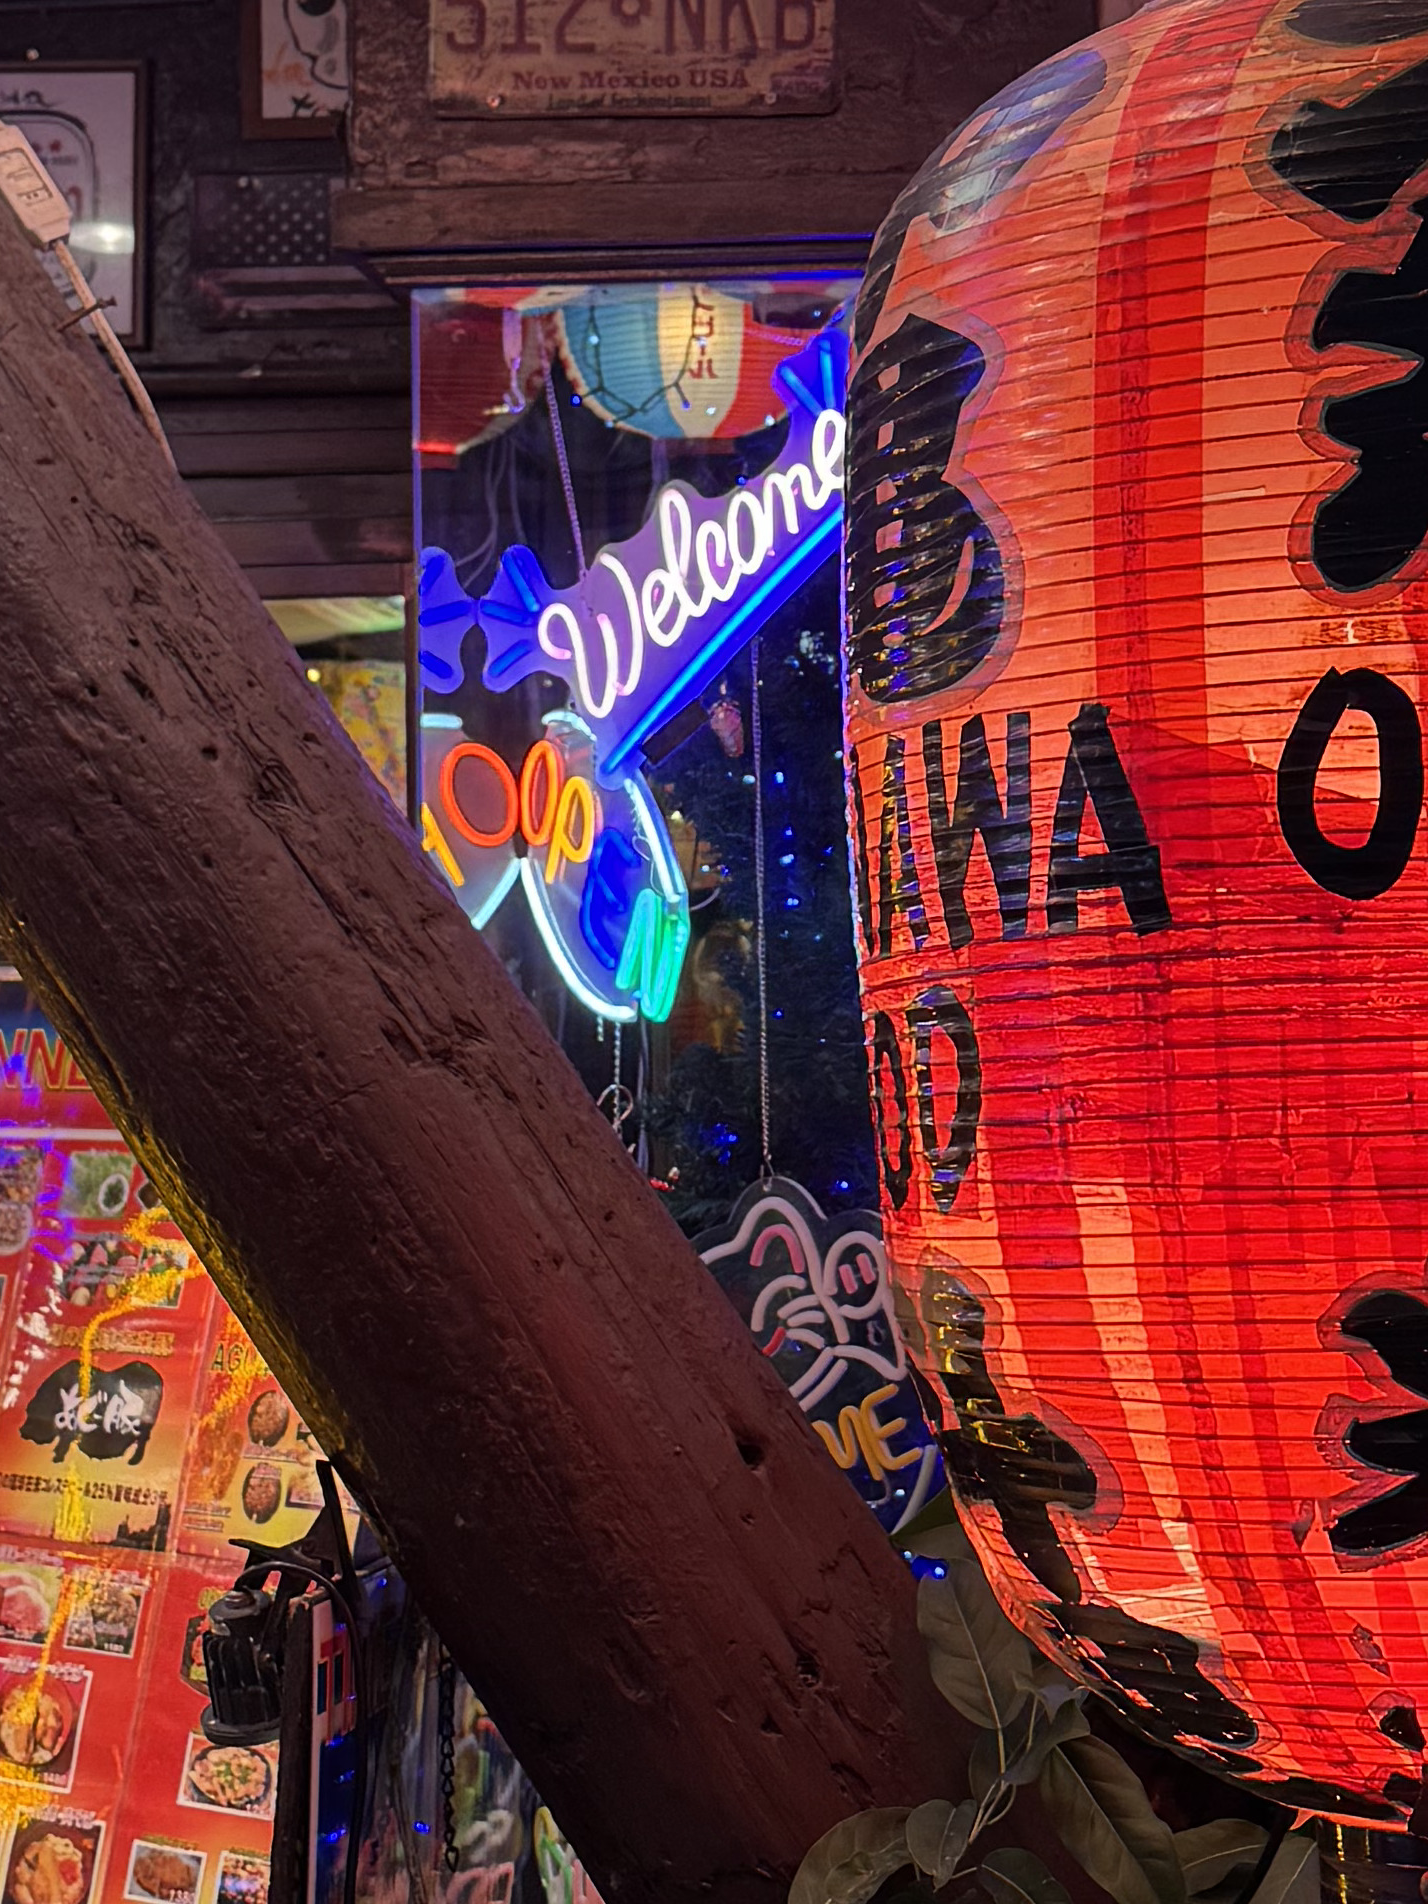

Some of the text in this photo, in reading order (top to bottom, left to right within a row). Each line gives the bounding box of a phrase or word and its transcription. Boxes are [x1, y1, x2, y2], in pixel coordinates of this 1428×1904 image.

[512, 70, 572, 92] New
[579, 68, 680, 91] Mexico
[689, 67, 749, 90] USA
